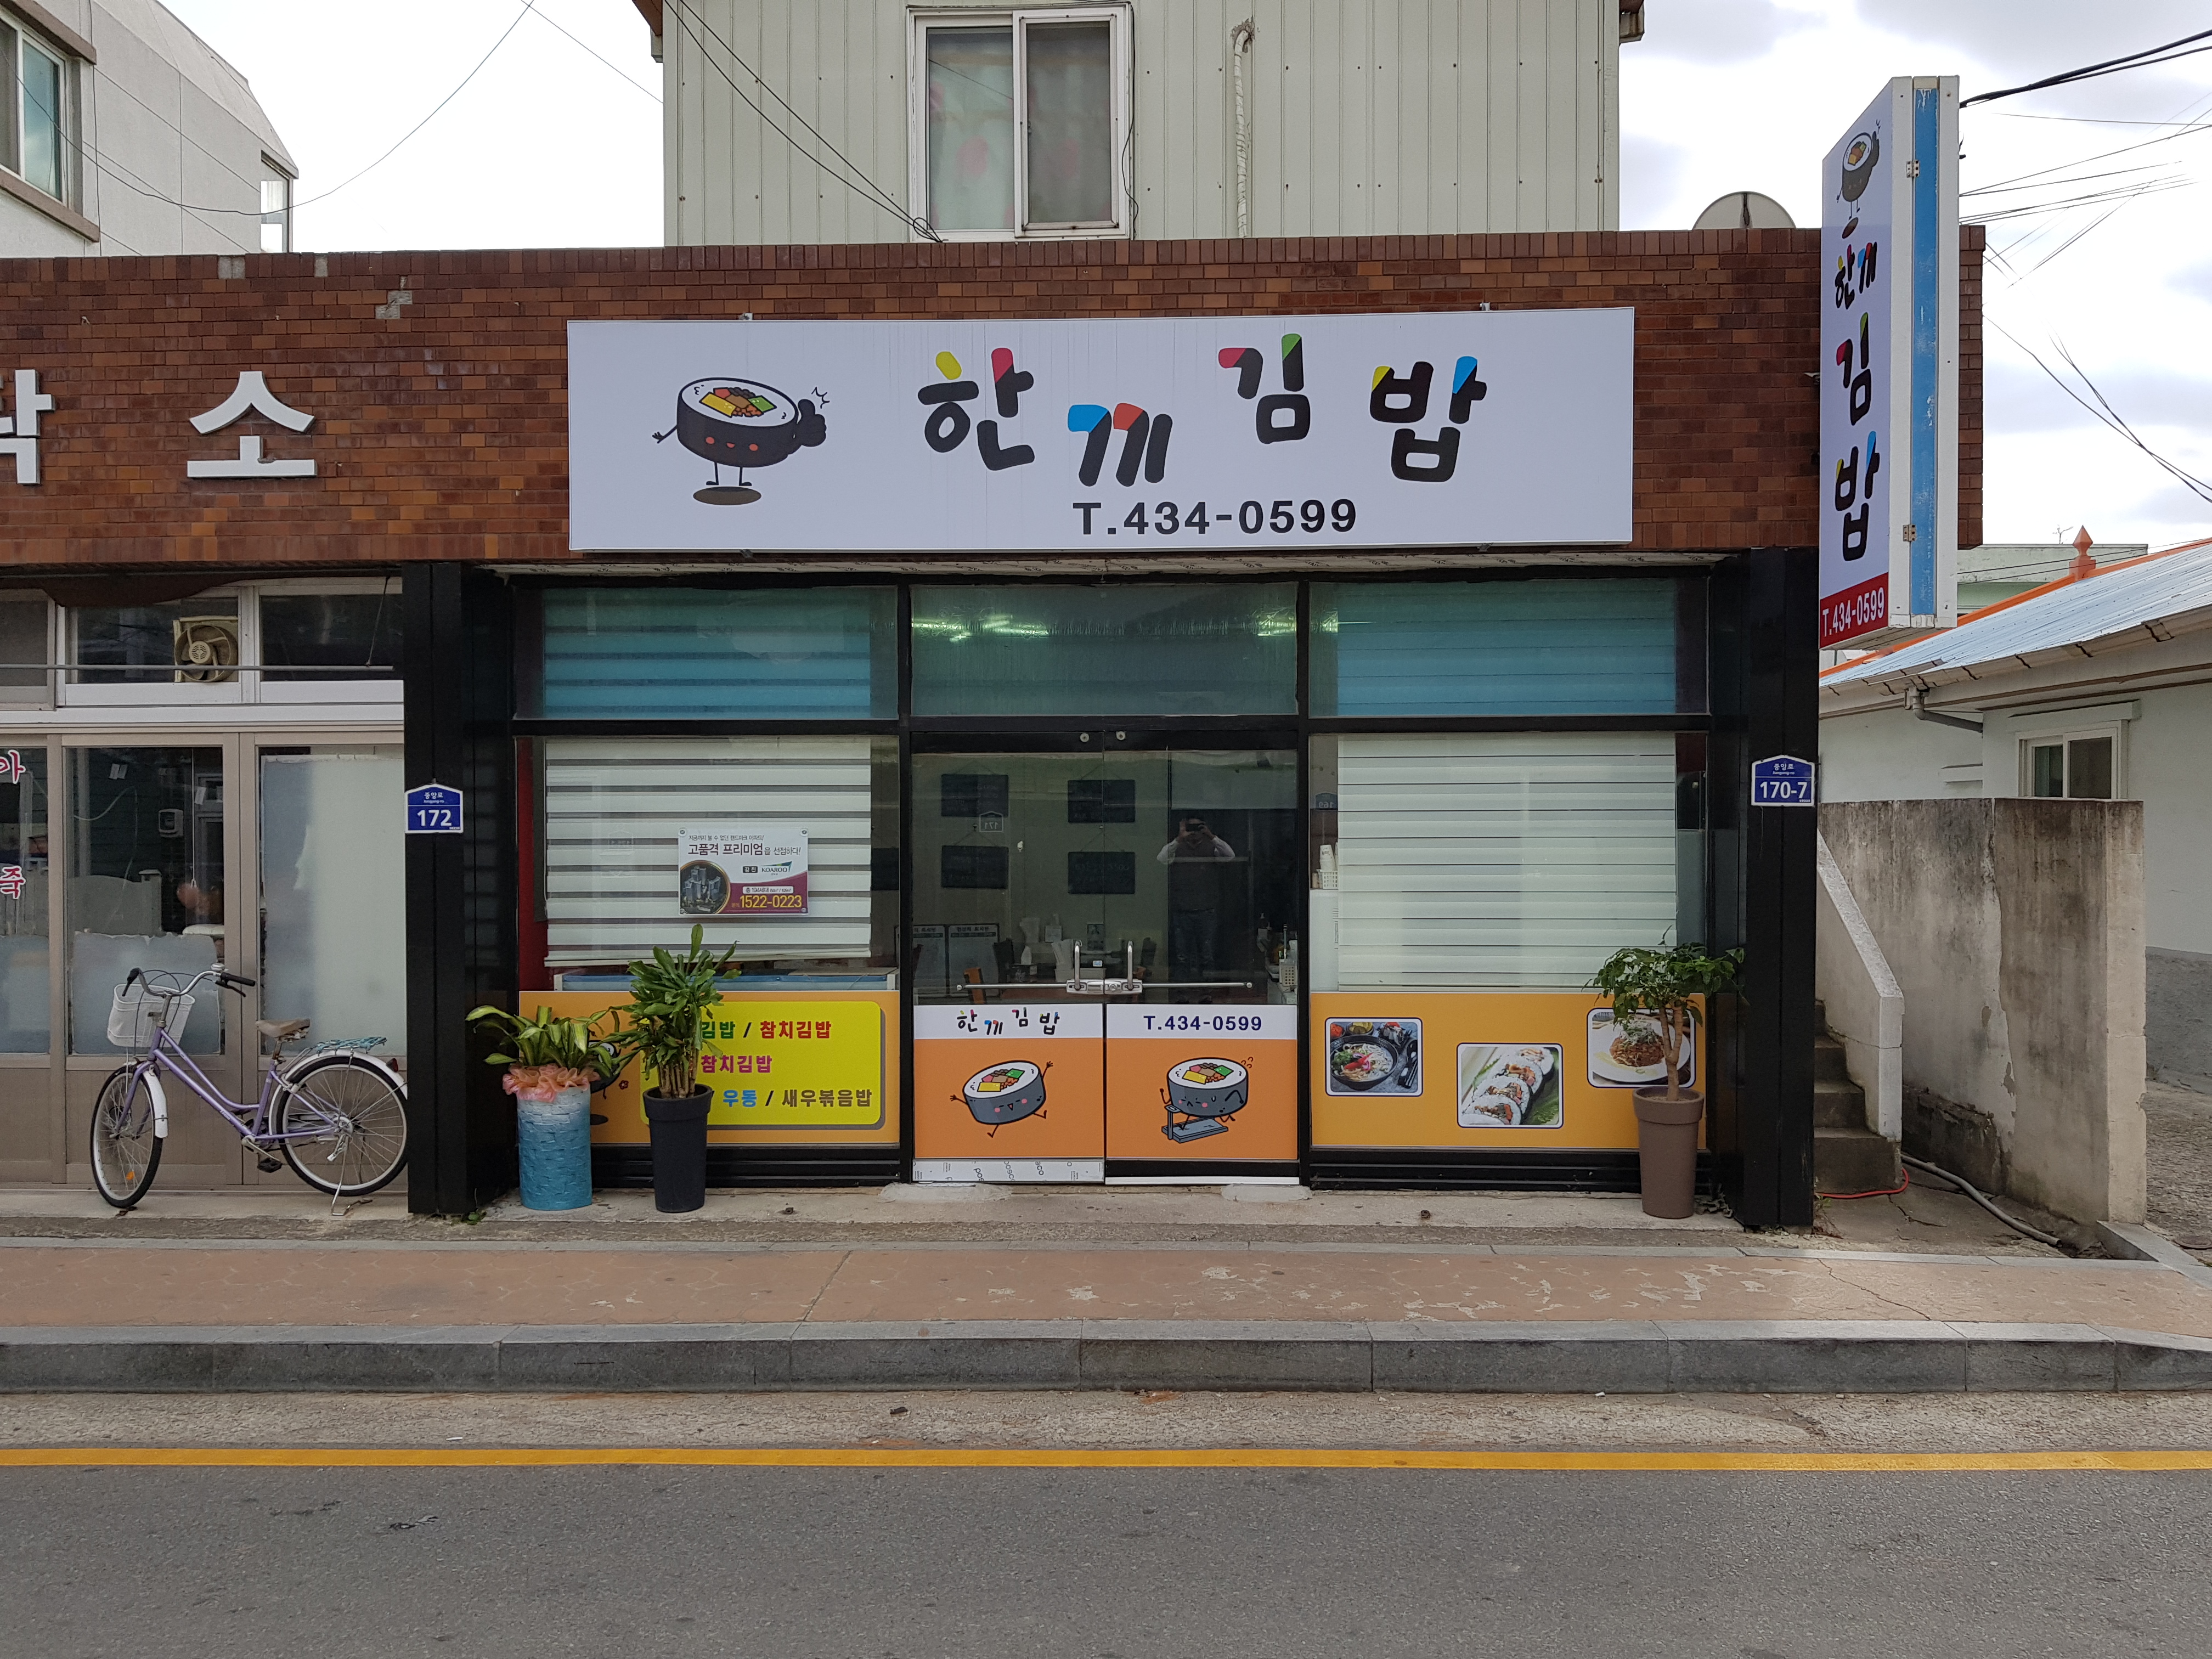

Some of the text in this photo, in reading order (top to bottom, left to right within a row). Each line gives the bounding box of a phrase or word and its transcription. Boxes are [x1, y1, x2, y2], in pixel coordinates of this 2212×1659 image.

[1073, 499, 1356, 535] T.434-0599
[1822, 586, 1884, 637] T.434-0599
[1760, 781, 1807, 799] 170-7
[417, 809, 452, 826] 172
[688, 843, 719, 856] 고품격
[774, 847, 802, 855] 선점하다!
[740, 895, 802, 908] 1522-0223
[760, 1020, 832, 1039] 참치김밥
[1143, 1015, 1262, 1031] T.434-0599
[701, 1055, 772, 1074] 참치김밥
[723, 1089, 758, 1108] 우동
[782, 1089, 872, 1108] 새우볶음밥
